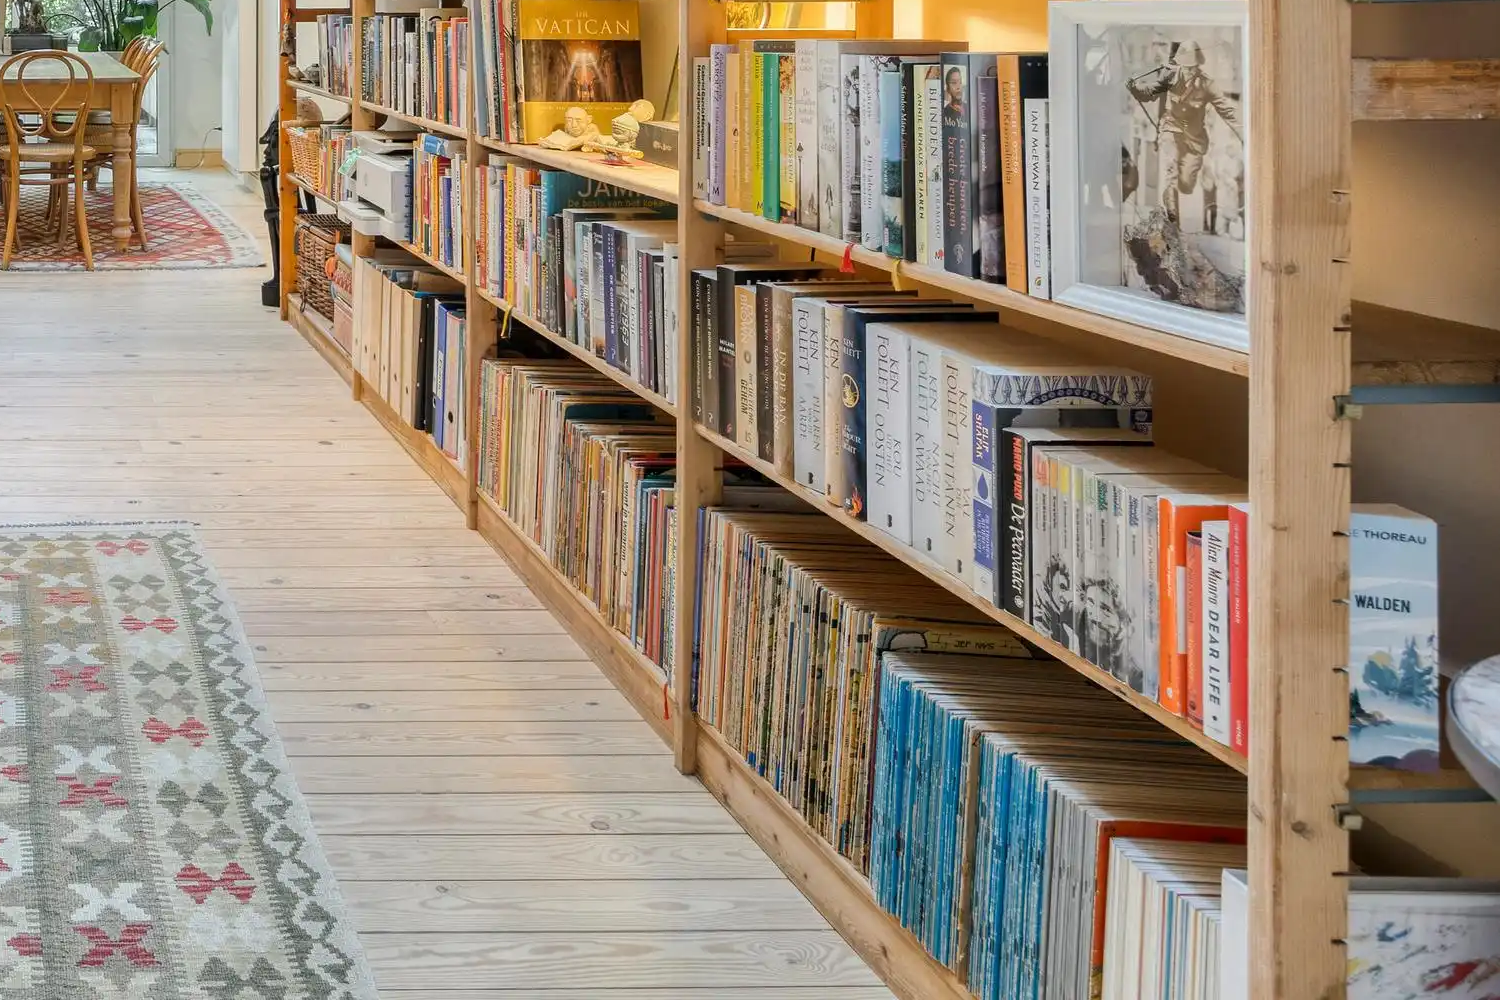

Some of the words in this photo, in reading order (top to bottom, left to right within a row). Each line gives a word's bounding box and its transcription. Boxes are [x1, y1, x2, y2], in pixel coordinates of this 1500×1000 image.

[534, 18, 632, 36] VATICAN
[929, 87, 939, 158] BLINDEN
[1031, 110, 1039, 133] IAN
[947, 136, 957, 174] brede
[959, 138, 968, 177] Grote
[1031, 137, 1040, 190] McEWAN
[947, 177, 957, 227] heupen
[958, 179, 968, 234] borsten,
[1032, 195, 1041, 269] BOETEKLEED
[620, 264, 629, 346] 22-11-1963
[740, 293, 748, 343] BROWN
[779, 350, 787, 366] IN
[798, 308, 809, 374] FOLLETT
[810, 328, 819, 360] KEN
[830, 337, 839, 369] KEN
[779, 371, 787, 391] DE
[877, 334, 889, 409] FOLLETT
[889, 357, 899, 394] KEN
[917, 350, 929, 429] FOLLETT
[740, 379, 748, 415] GEHEIM
[779, 396, 787, 425] BAN
[929, 375, 938, 411] KEN
[946, 364, 959, 444] FOLLETT
[959, 390, 968, 428] KEN
[799, 396, 808, 441] AARDE
[812, 395, 821, 452] PILAREN
[875, 412, 885, 487] OOSTEN
[893, 437, 901, 478] KOU
[915, 432, 925, 503] KWAAD
[1012, 437, 1023, 471] MARIO
[932, 441, 941, 507] NACHT
[1013, 474, 1024, 501] PUZO
[945, 452, 956, 537] TITANEN
[962, 487, 971, 518] VAL
[1011, 502, 1025, 524] De
[1208, 532, 1222, 562] Alice
[1362, 529, 1428, 546] THOREAU
[1008, 526, 1025, 594] Peetvader
[1208, 567, 1222, 605] Munro
[1354, 594, 1411, 613] WALDEN
[1209, 609, 1220, 659] DEAR
[1209, 665, 1221, 706] LIFE
